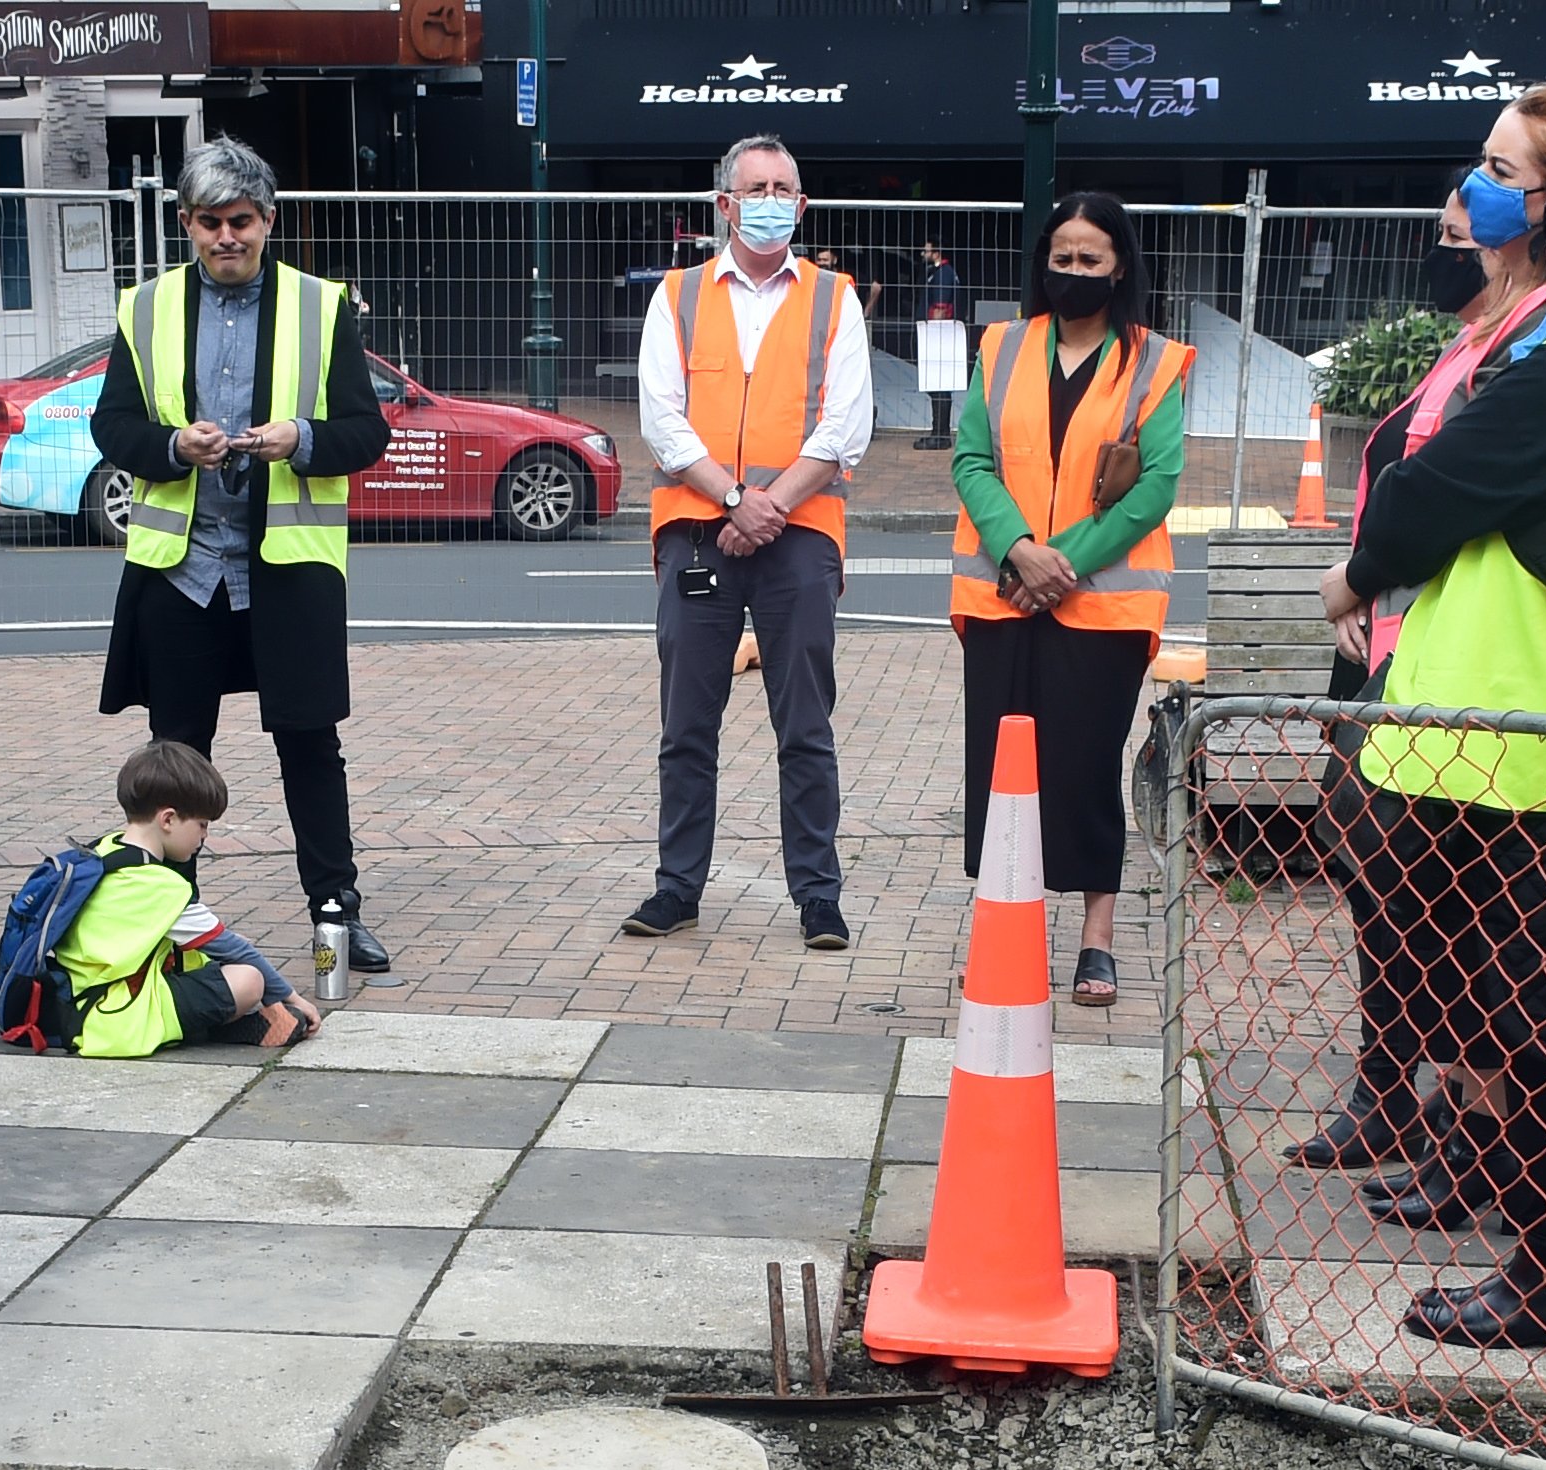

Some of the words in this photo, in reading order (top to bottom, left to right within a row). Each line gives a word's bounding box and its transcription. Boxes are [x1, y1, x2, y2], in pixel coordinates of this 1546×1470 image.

[524, 63, 531, 80] P
[639, 85, 844, 103] Heineken
[1368, 82, 1526, 101] Heinek
[1148, 99, 1199, 118] Club
[45, 407, 80, 419] 0800
[407, 430, 436, 440] Cleaning
[385, 453, 410, 463] Prompt
[411, 454, 436, 462] Service
[396, 466, 411, 474] Free
[412, 466, 436, 475] Quotes
